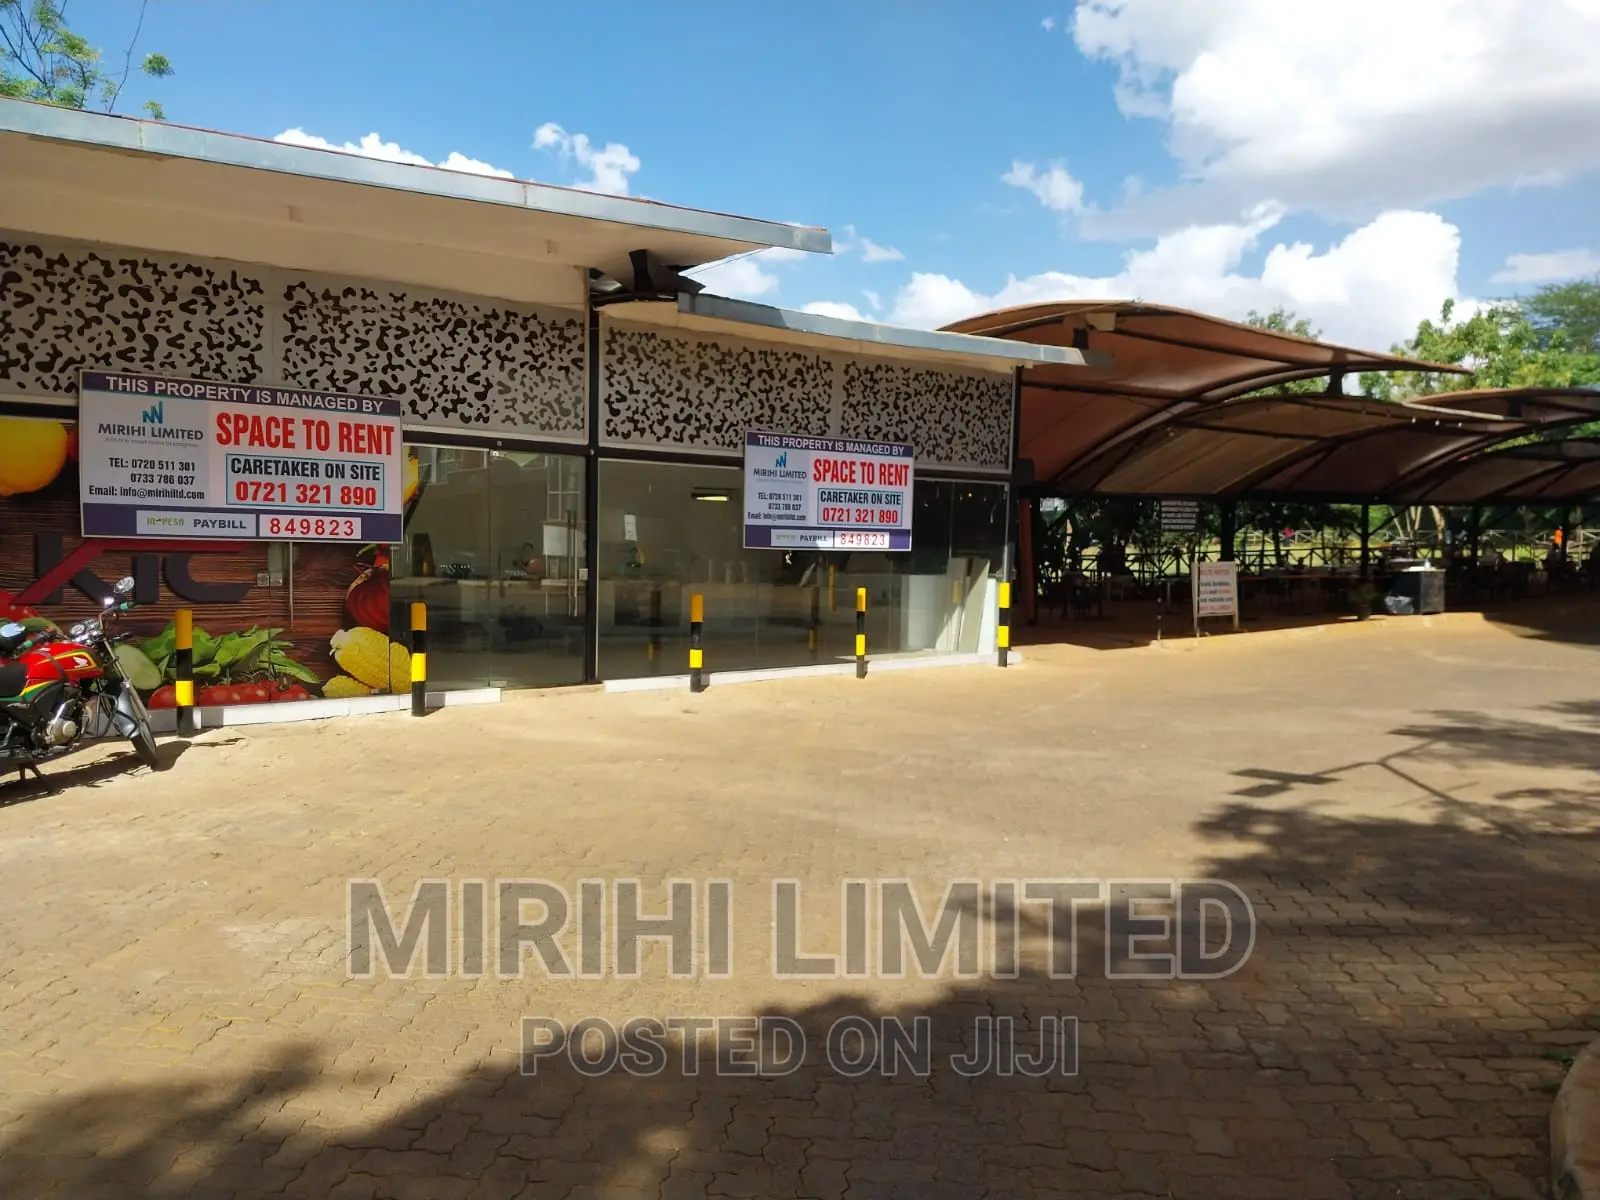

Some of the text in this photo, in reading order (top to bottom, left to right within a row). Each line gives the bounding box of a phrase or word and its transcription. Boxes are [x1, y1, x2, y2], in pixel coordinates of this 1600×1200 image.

[106, 376, 384, 413] THIS PROPERTY IS MANAGED BY
[98, 423, 204, 440] MIRIHI LIMITED
[216, 412, 395, 456] SPACE TO RENT
[758, 434, 904, 456] THIS PROPERTY IS MANAGED BY
[109, 458, 195, 472] TEL: 0720 511 301
[230, 457, 380, 481] CARETAKER ON SITE
[753, 468, 807, 479] MIRIHI LIMITED
[813, 458, 910, 486] SPACE TO RENT
[130, 473, 195, 486] 0733 786 037
[89, 485, 118, 496] Email:
[235, 480, 376, 506] 0721 321 890
[820, 491, 901, 506] CARETAKER ON SITE
[822, 508, 898, 524] 0721 321 890
[193, 518, 246, 530] PAYBILL
[270, 518, 354, 536] 849823
[800, 534, 828, 542] PAYBILL
[840, 533, 886, 546] 849823
